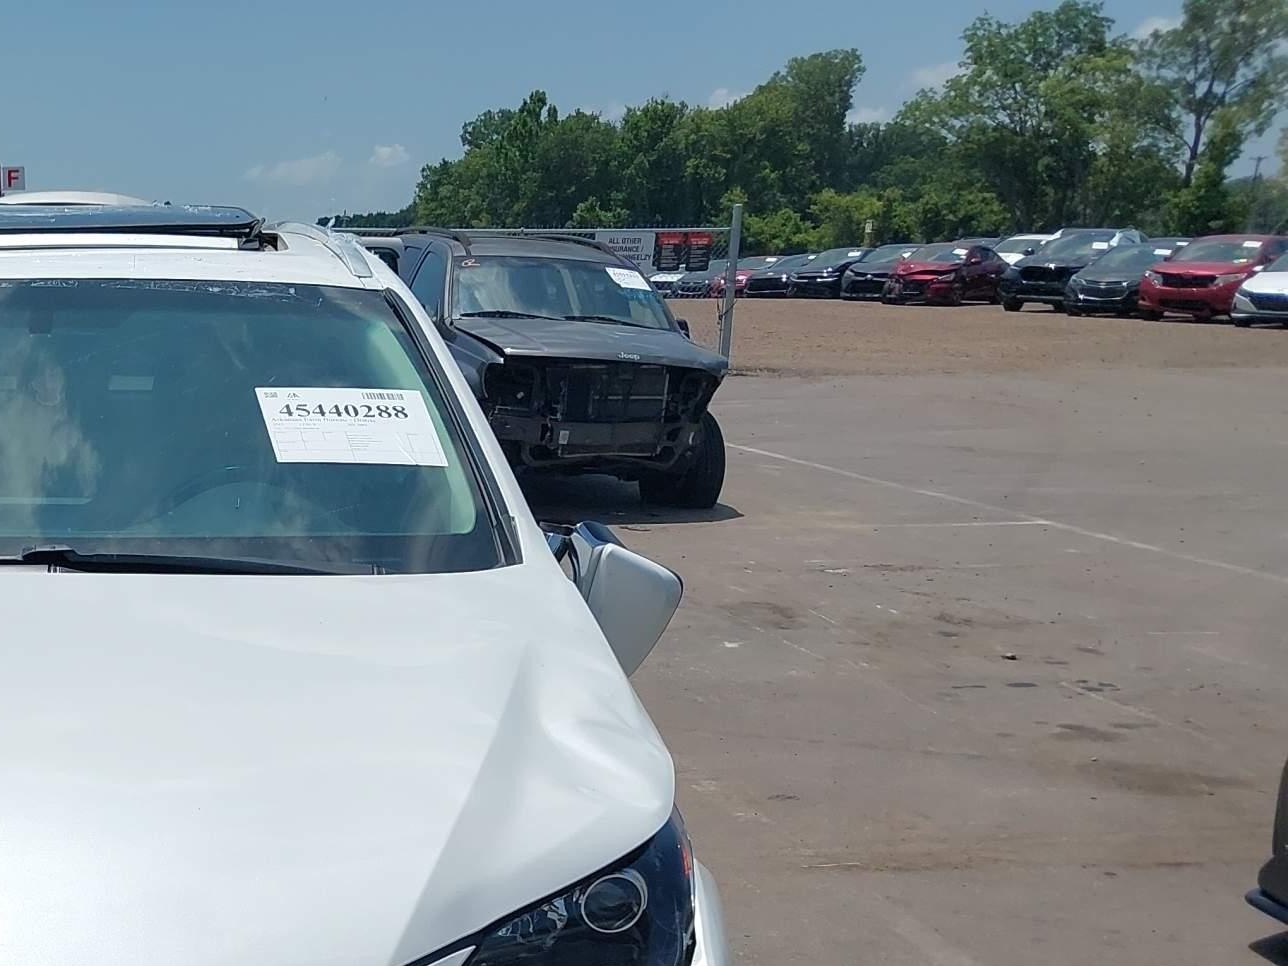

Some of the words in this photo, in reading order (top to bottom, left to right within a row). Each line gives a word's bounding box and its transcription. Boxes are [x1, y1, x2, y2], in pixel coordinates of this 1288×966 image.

[8, 169, 20, 187] F
[617, 351, 641, 360] Jeep
[279, 403, 409, 420] 45440288
